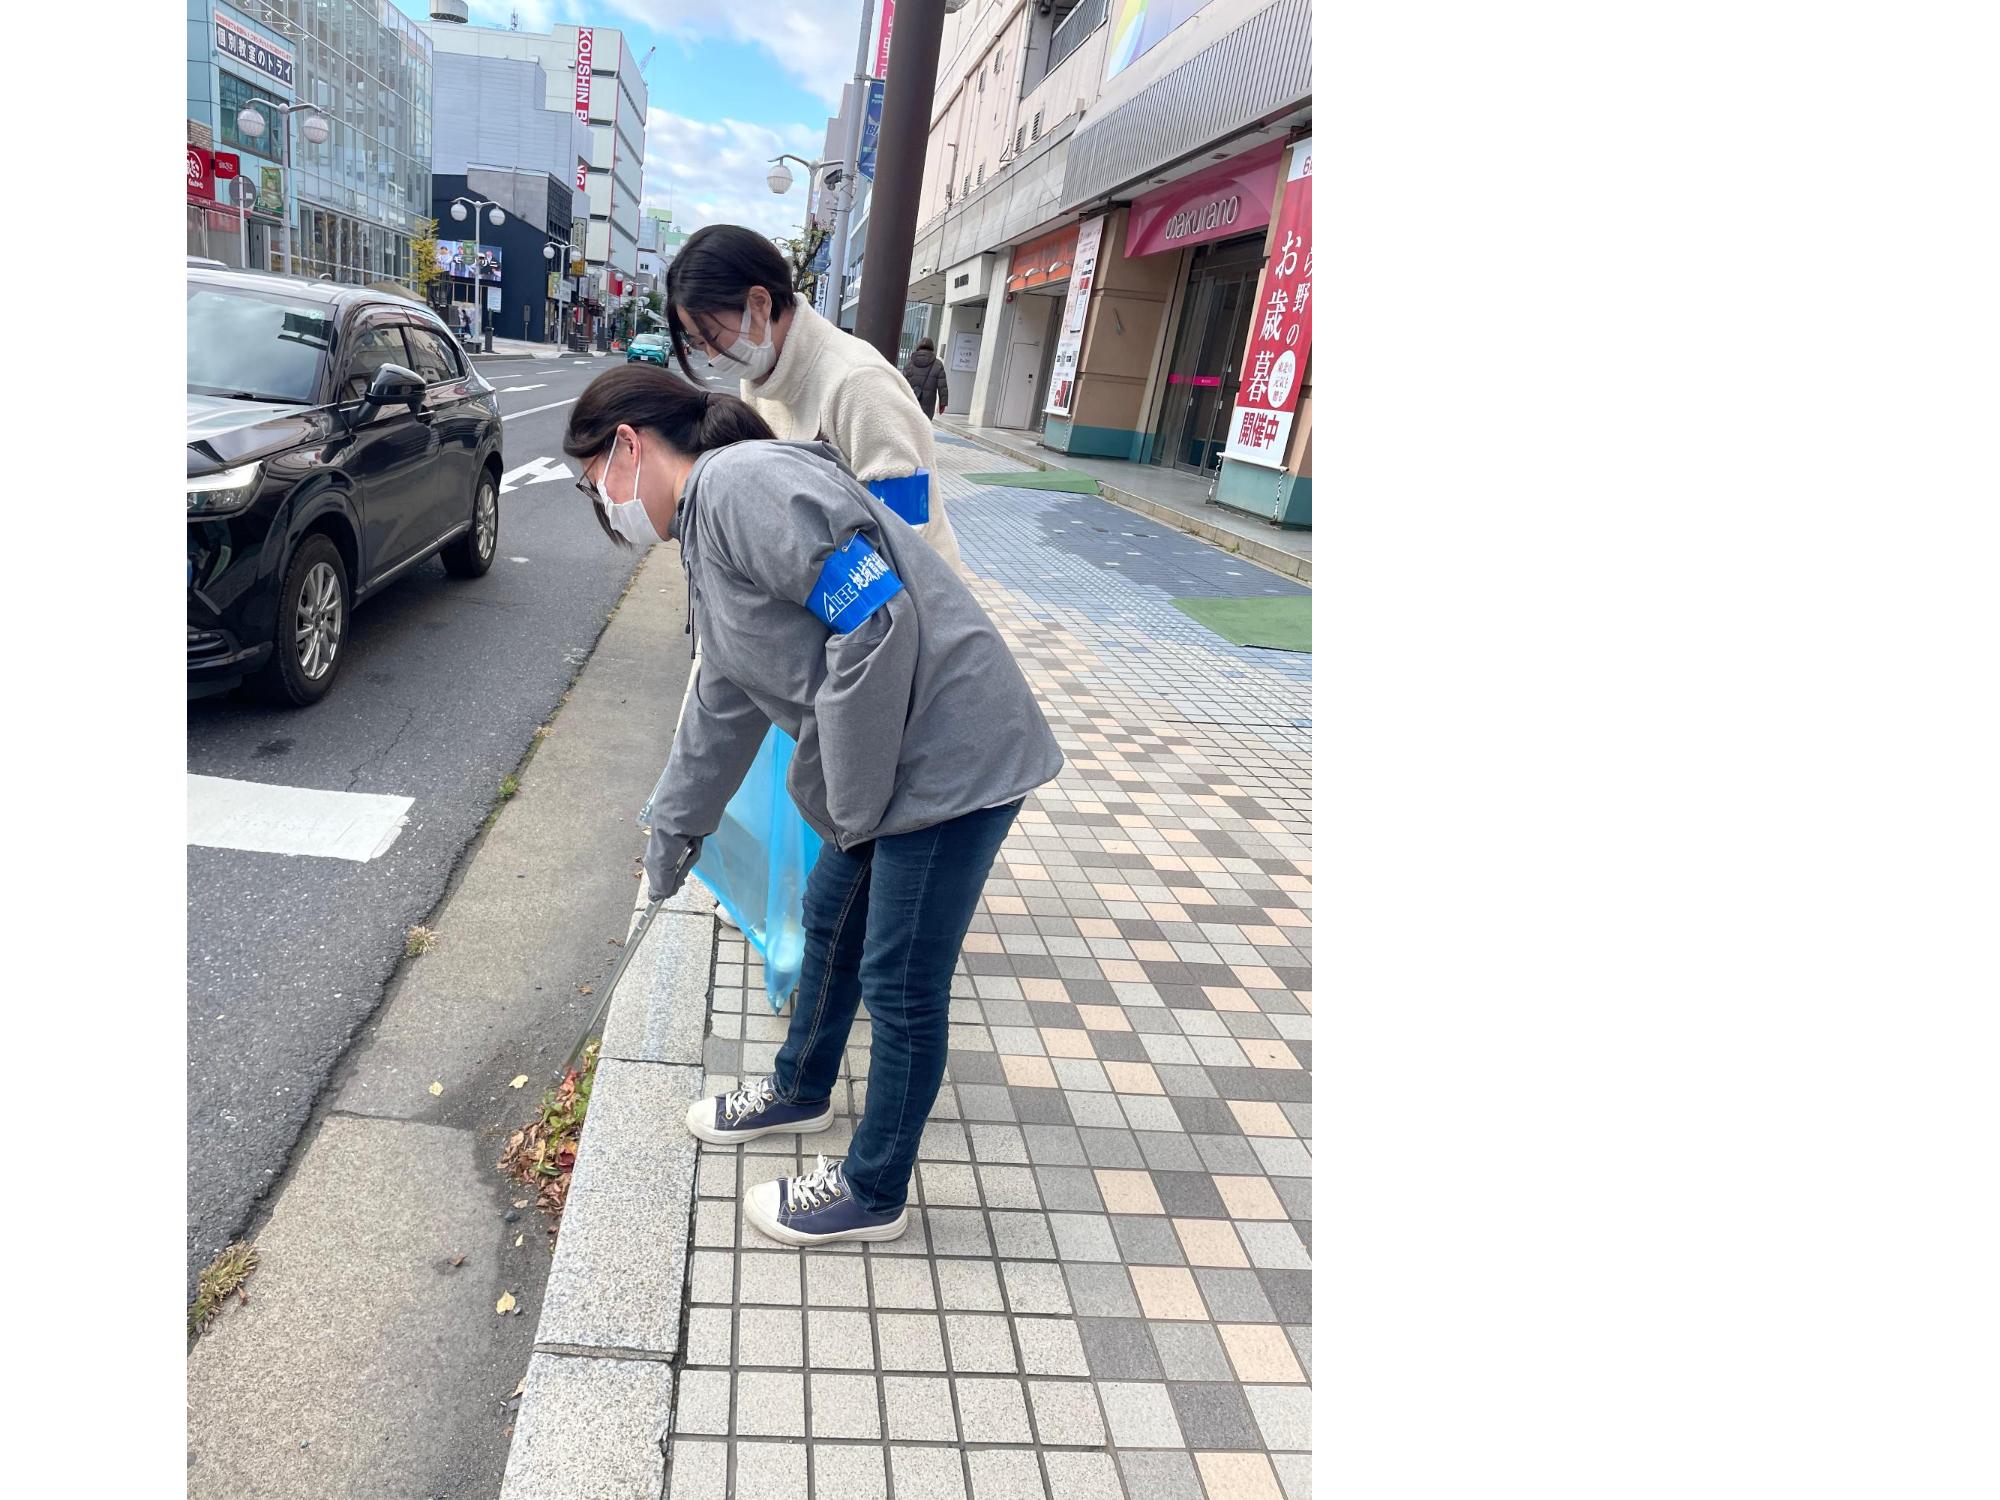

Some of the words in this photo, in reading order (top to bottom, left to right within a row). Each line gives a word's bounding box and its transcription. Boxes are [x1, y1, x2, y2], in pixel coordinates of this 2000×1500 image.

[217, 25, 291, 81] 個別教室のトライ
[577, 28, 592, 103] KOUSHIN
[1246, 230, 1302, 403] お歳暮
[1238, 411, 1280, 450] 開催中
